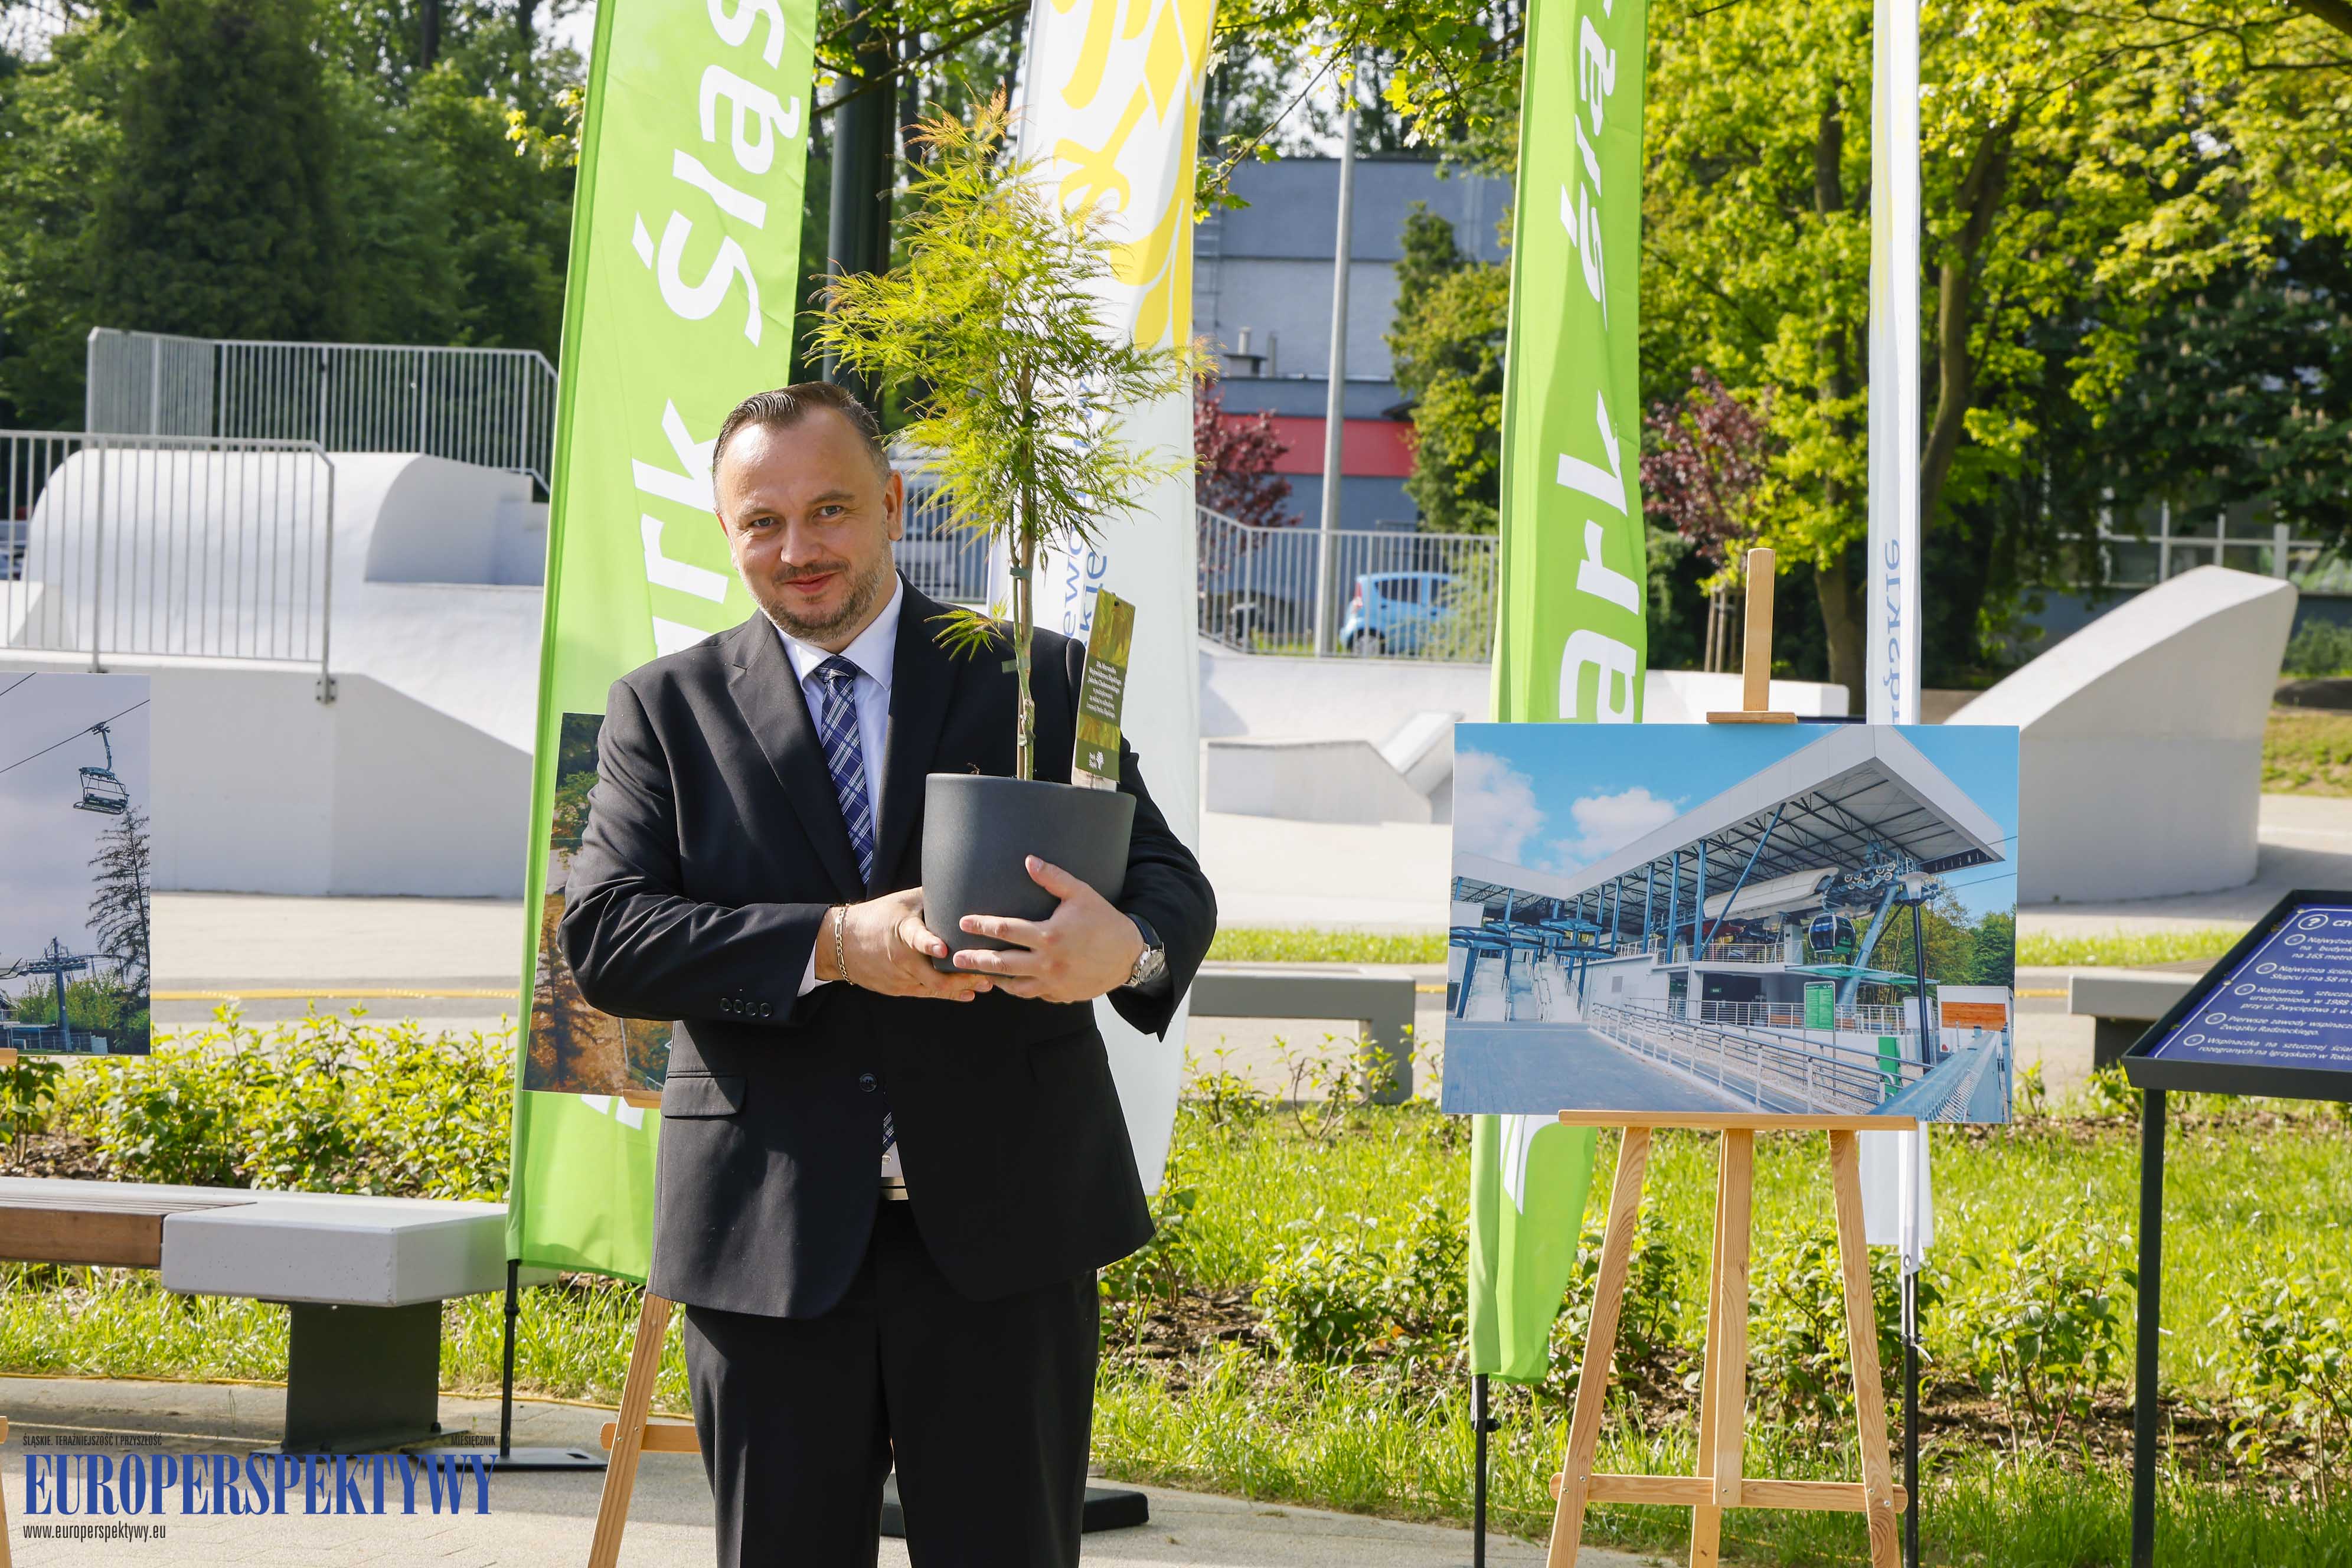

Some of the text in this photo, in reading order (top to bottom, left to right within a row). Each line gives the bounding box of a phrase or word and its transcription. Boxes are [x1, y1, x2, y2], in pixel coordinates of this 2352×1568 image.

[2258, 986, 2304, 995] Najstarsza
[2249, 995, 2311, 1004] uruchomiona
[2228, 1015, 2269, 1024] Pierwsze
[2271, 1019, 2306, 1027] zawody
[2207, 1037, 2260, 1047] Wspinaczka
